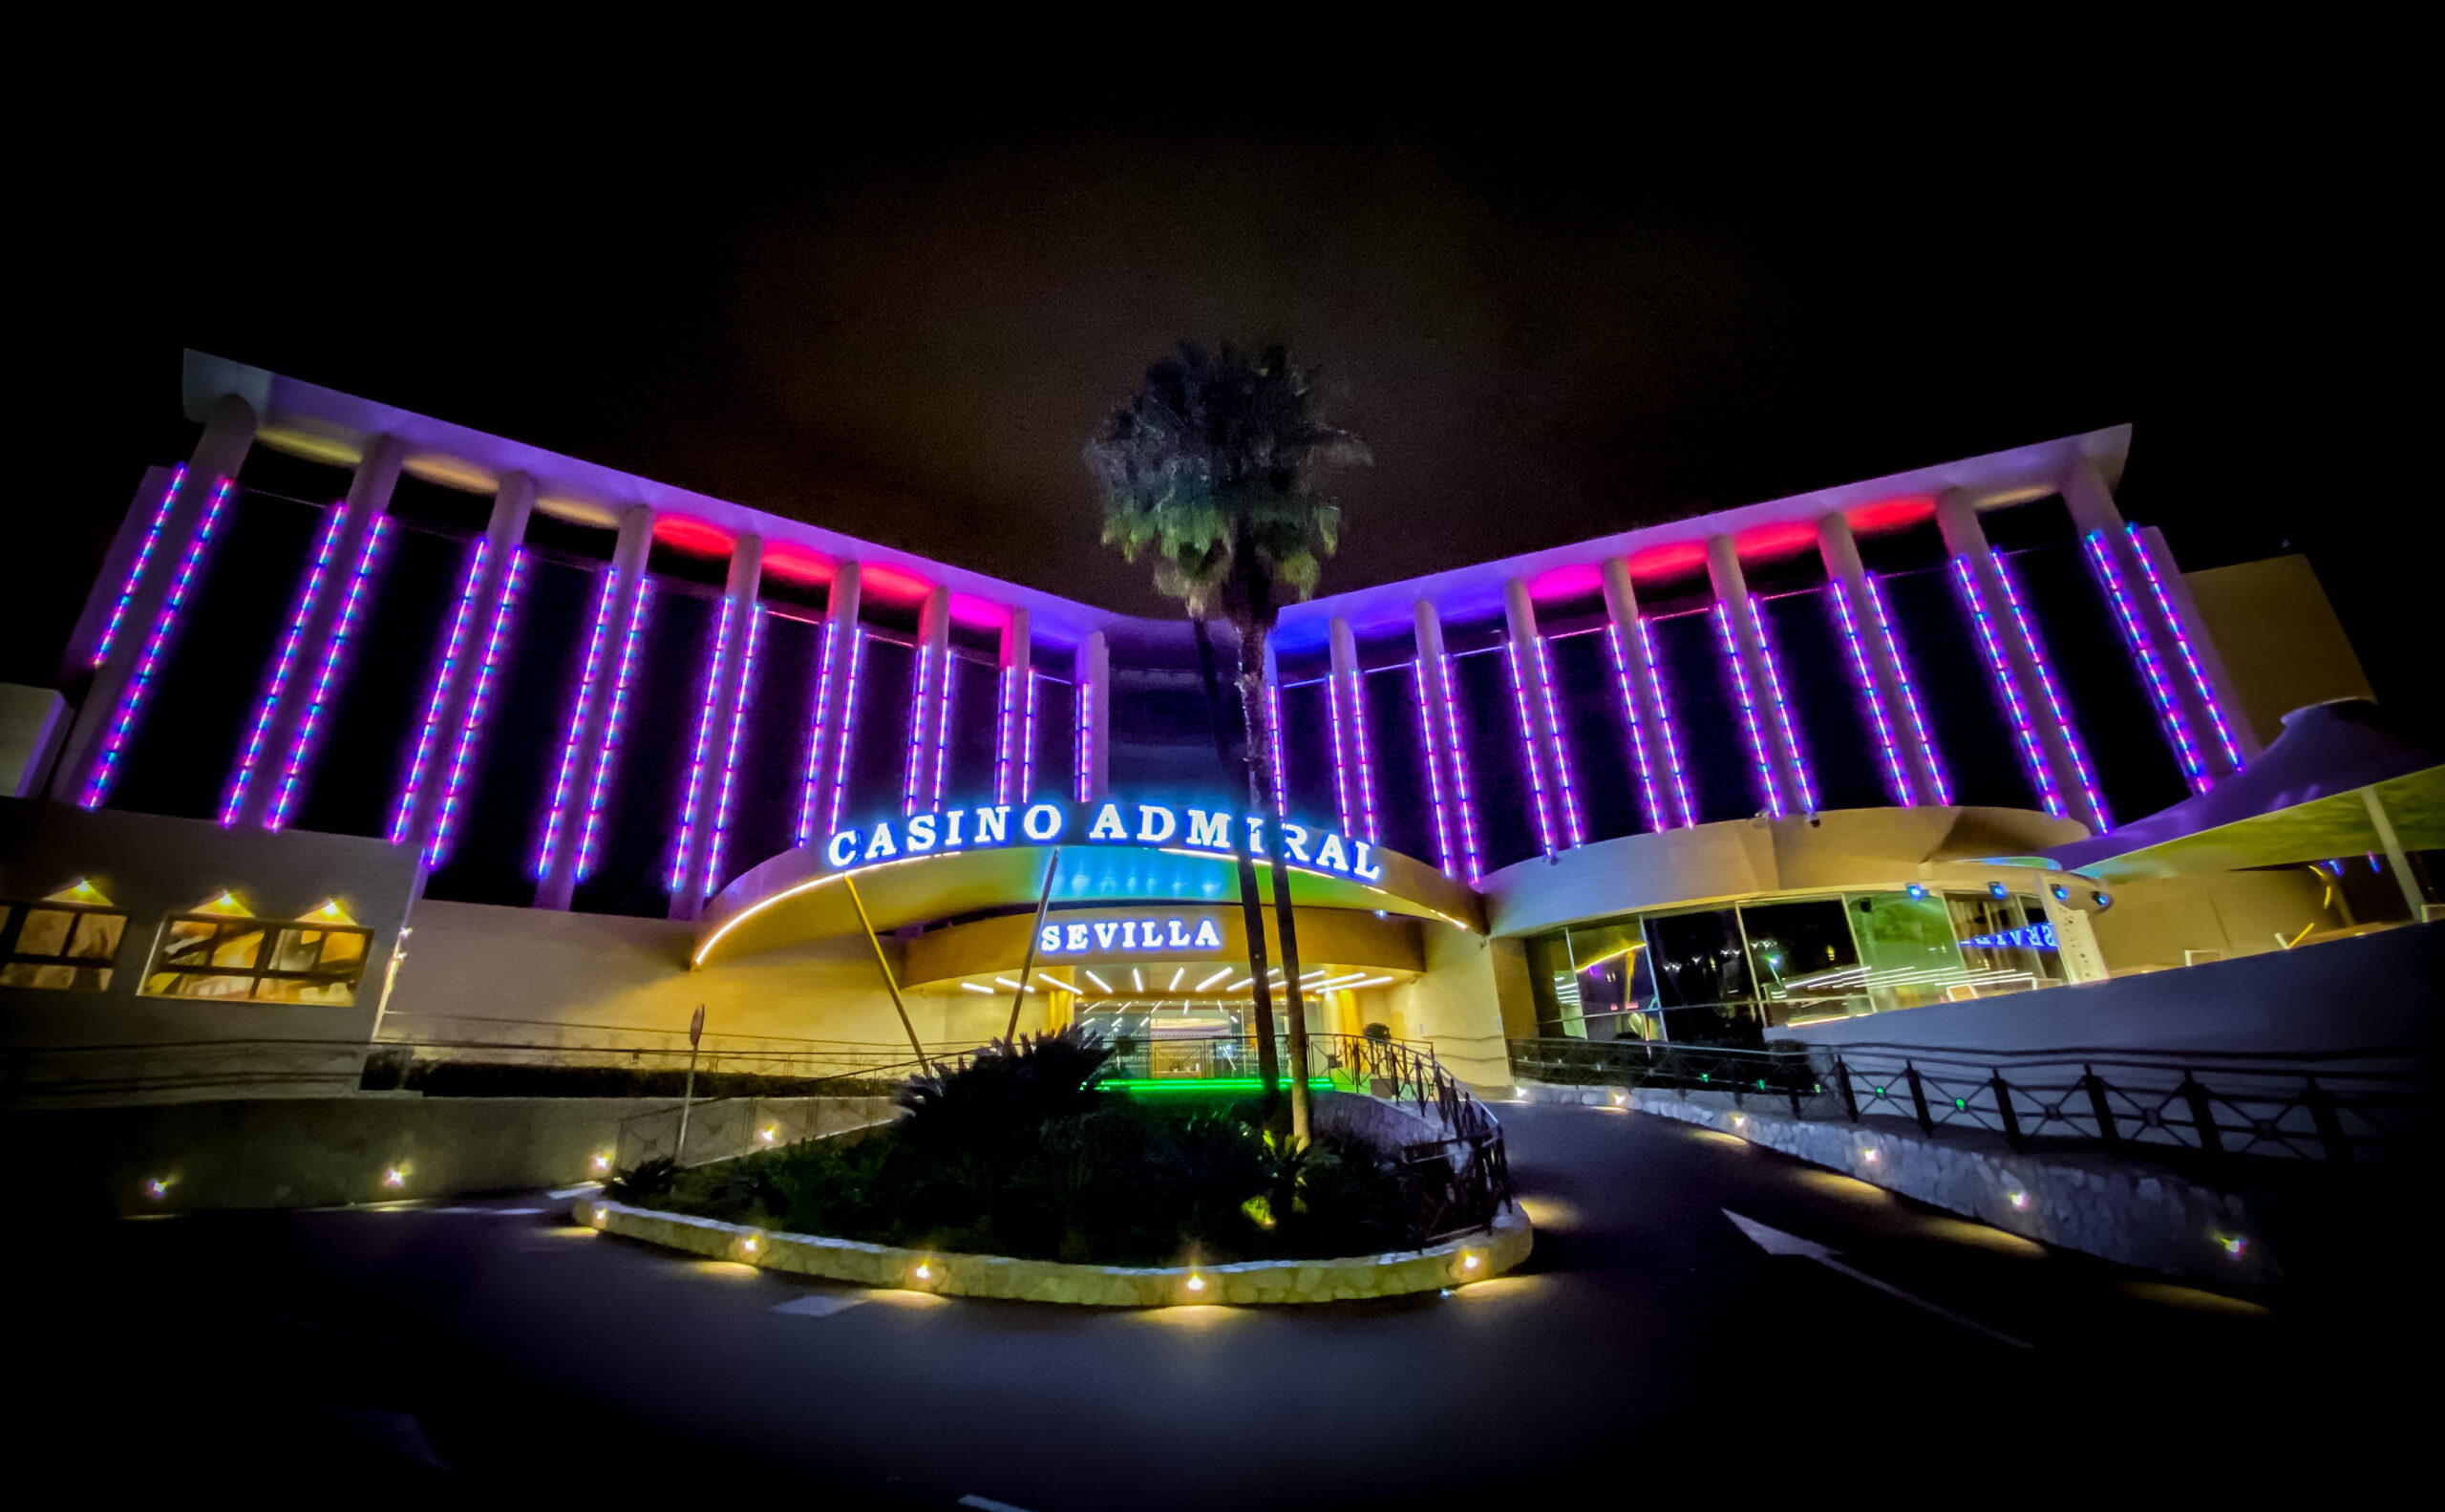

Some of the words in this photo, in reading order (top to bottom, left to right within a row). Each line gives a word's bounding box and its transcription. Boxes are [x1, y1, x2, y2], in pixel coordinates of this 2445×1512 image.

[828, 804, 1062, 867] CASINO
[1089, 804, 1380, 880] ADMIRAL
[1041, 920, 1220, 951] SEVILLA
